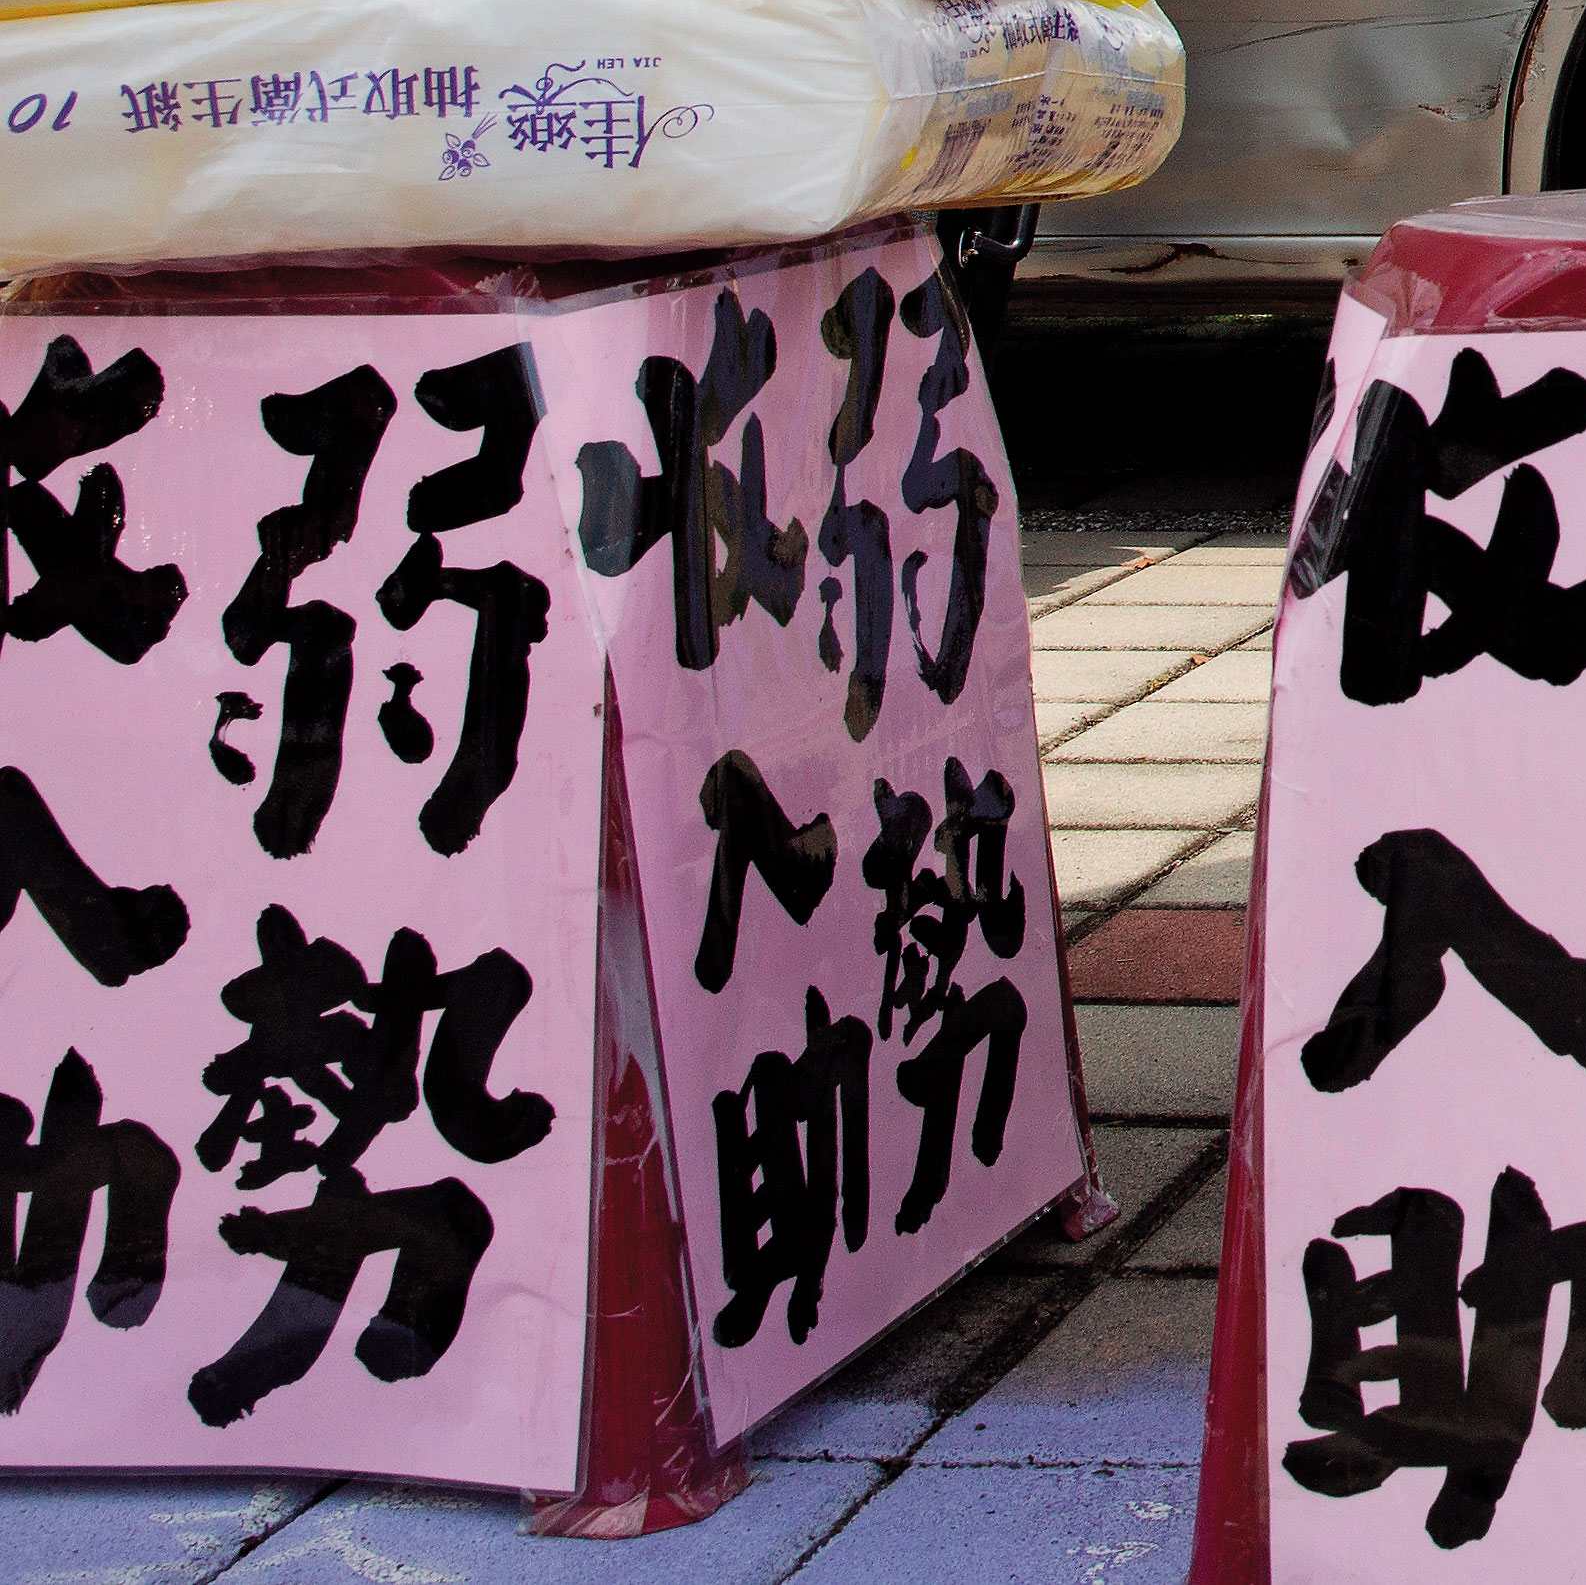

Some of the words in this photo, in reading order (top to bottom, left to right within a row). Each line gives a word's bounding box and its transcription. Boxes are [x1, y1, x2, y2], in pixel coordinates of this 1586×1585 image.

[597, 58, 624, 71] LEH
[635, 55, 662, 68] JIA
[120, 65, 481, 134] 抽取式衛生紙
[500, 81, 675, 168] 佳樂
